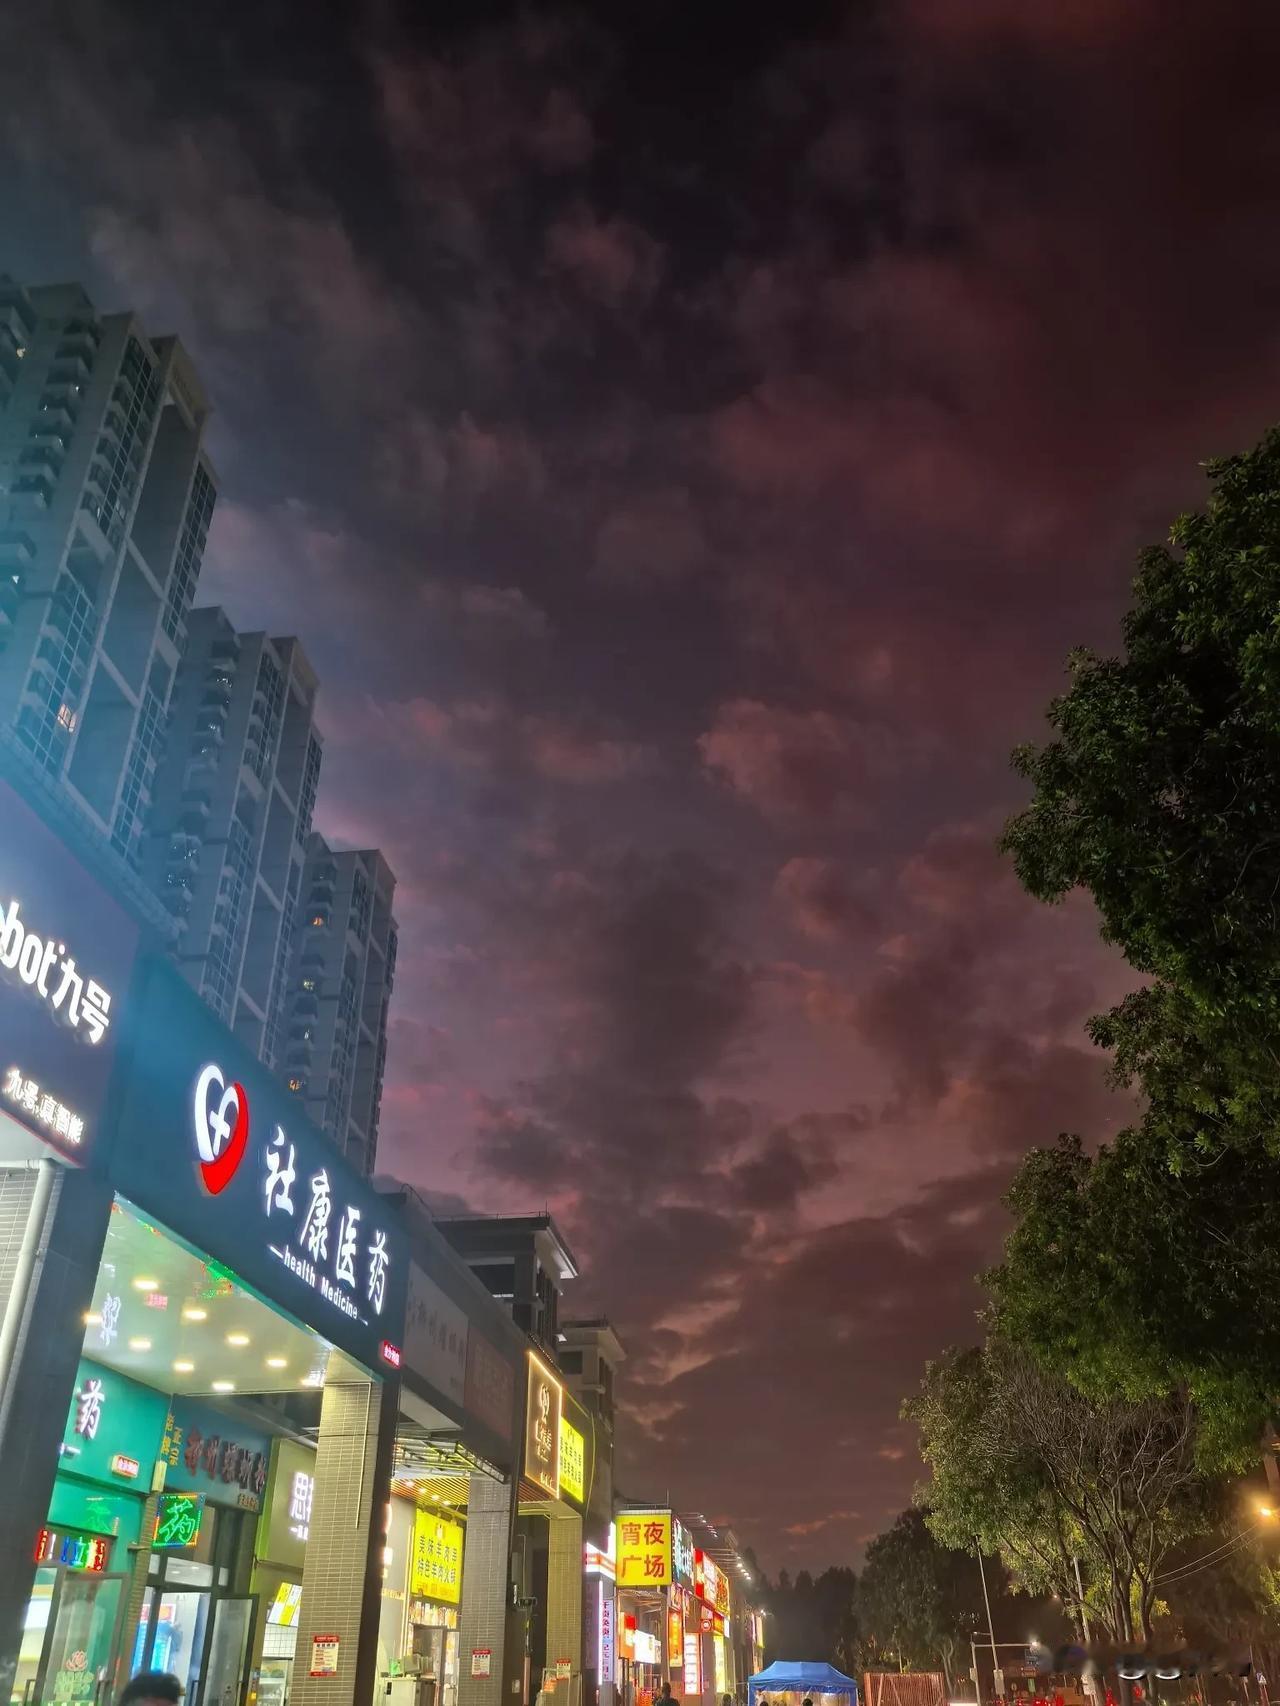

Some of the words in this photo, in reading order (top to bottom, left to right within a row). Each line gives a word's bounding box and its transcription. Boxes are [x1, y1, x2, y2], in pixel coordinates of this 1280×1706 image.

[52, 958, 111, 1044] 九号
[265, 1125, 389, 1316] 社康医药
[283, 1244, 316, 1288] health
[321, 1276, 359, 1320] Medicine
[158, 1498, 194, 1543] 药
[622, 1522, 665, 1546] 宵夜
[622, 1554, 665, 1578] 广场
